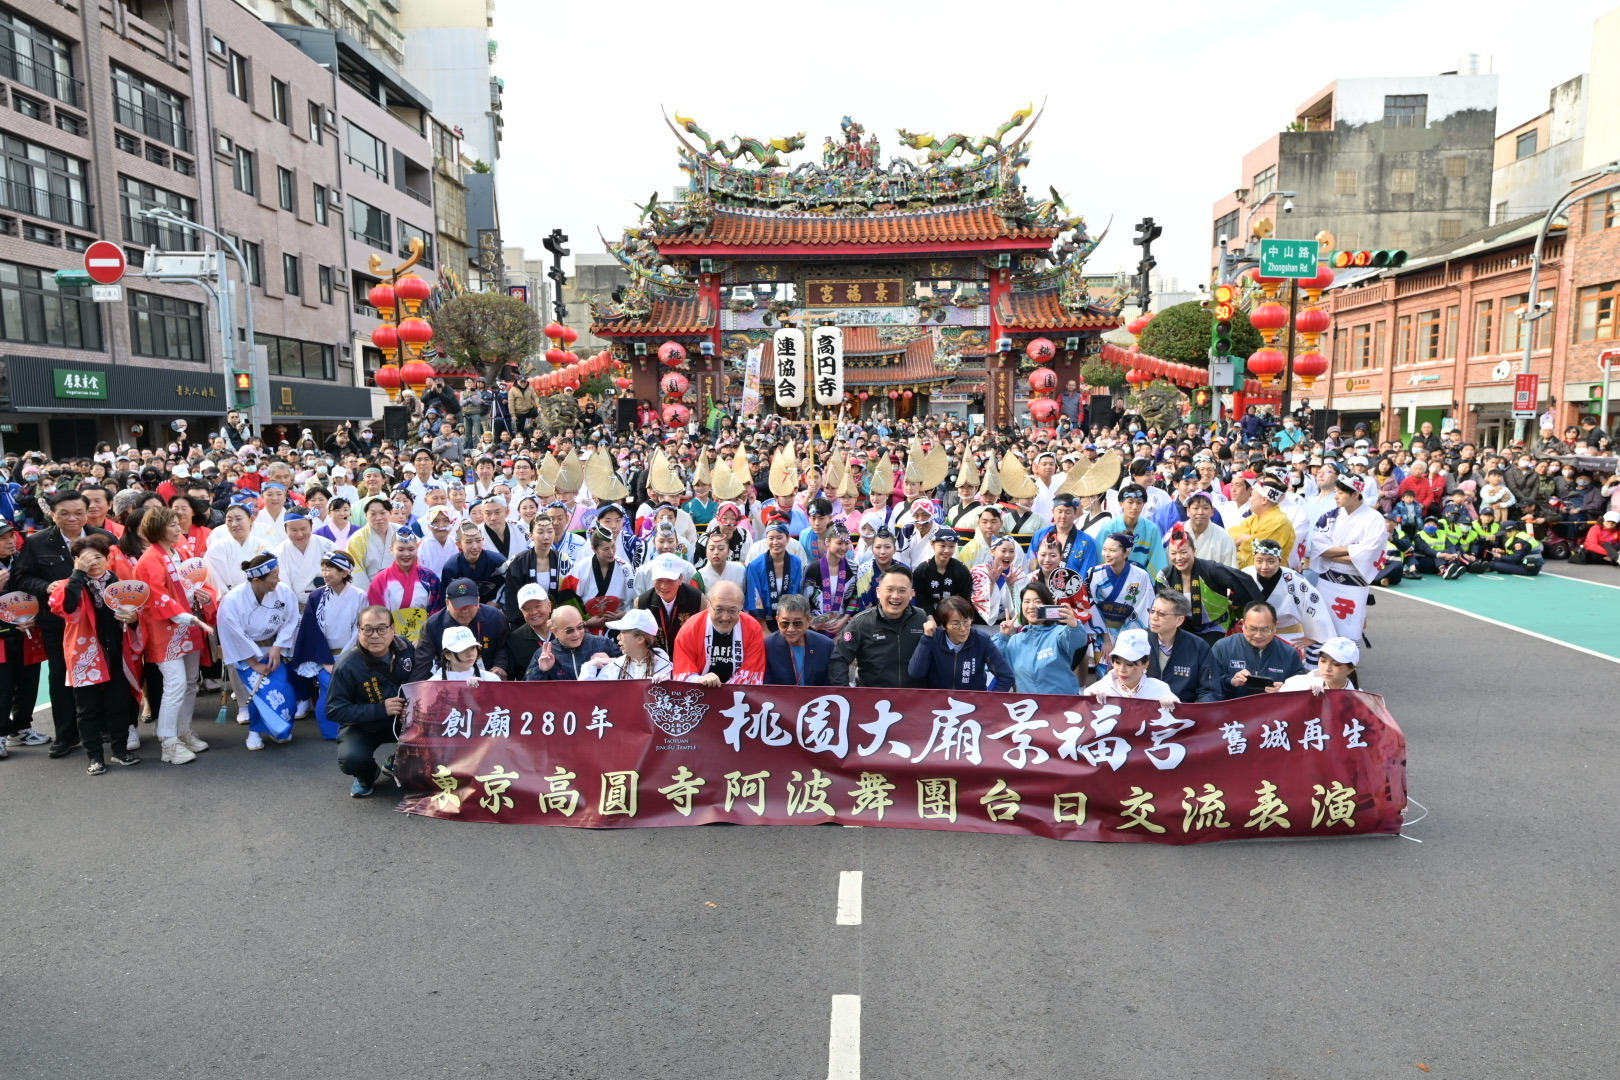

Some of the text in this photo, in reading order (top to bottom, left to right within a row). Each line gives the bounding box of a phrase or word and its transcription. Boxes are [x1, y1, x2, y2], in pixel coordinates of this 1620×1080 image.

[1268, 244, 1310, 259] 中山路
[1268, 262, 1309, 274] Zhongshan Rd.
[820, 282, 888, 303] 景福宮
[1216, 305, 1229, 319] 50
[777, 336, 797, 399] 連協会
[816, 334, 837, 397] 高円寺
[441, 706, 613, 739] 創廟280年
[719, 691, 1196, 771] 桃園大廟景福宮
[1218, 717, 1368, 755] 舊城再生
[431, 764, 1357, 832] 東京高圓寺阿波舞團台日交流表演
